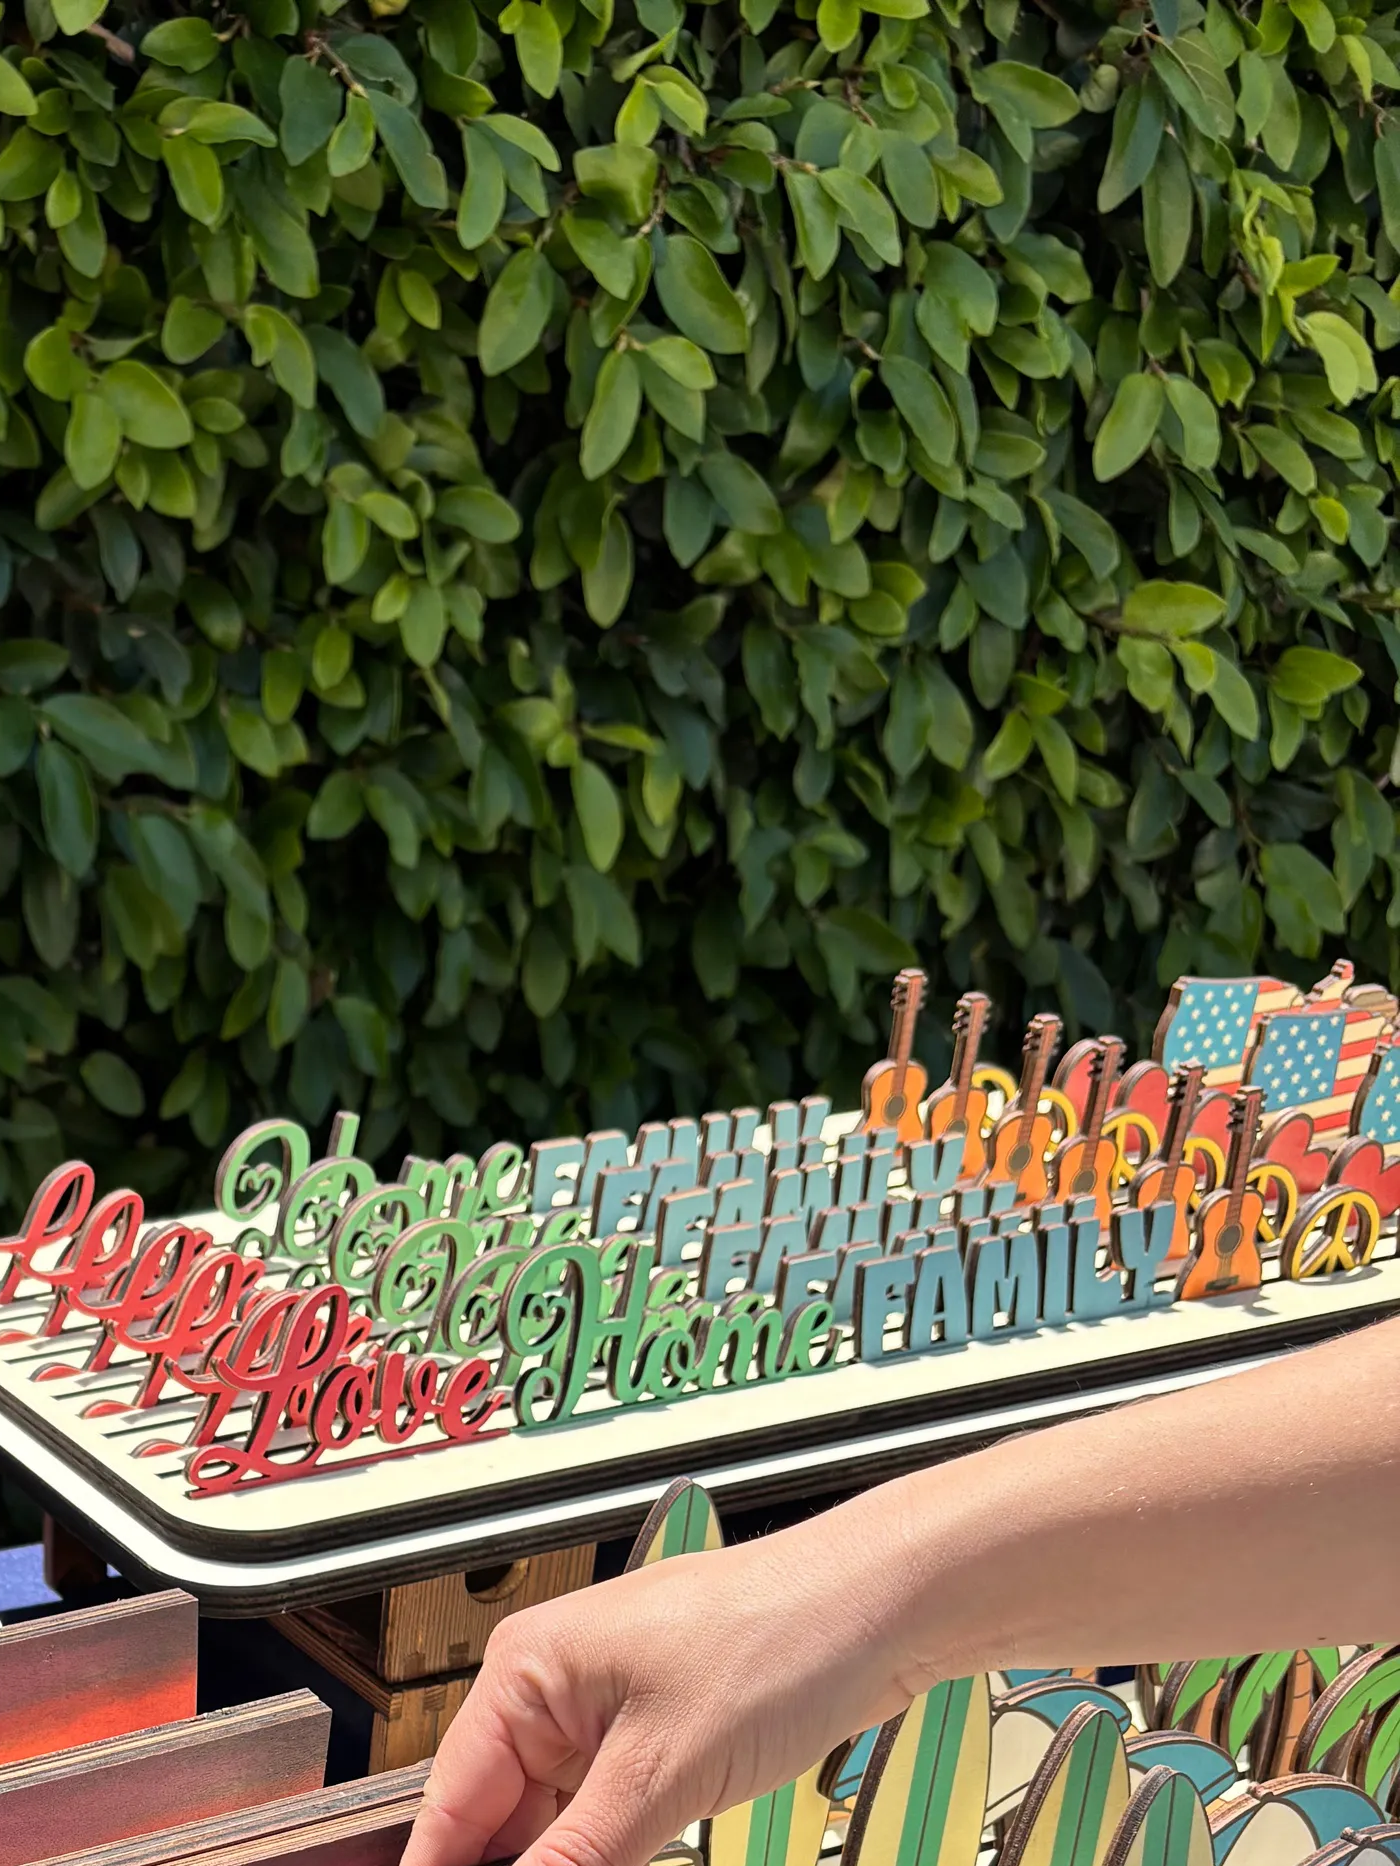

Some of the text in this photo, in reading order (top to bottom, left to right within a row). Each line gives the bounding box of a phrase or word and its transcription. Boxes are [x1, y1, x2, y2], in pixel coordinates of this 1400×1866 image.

[502, 1239, 838, 1428] Home
[855, 1200, 1176, 1362] FAMILY
[184, 1284, 506, 1494] Love
